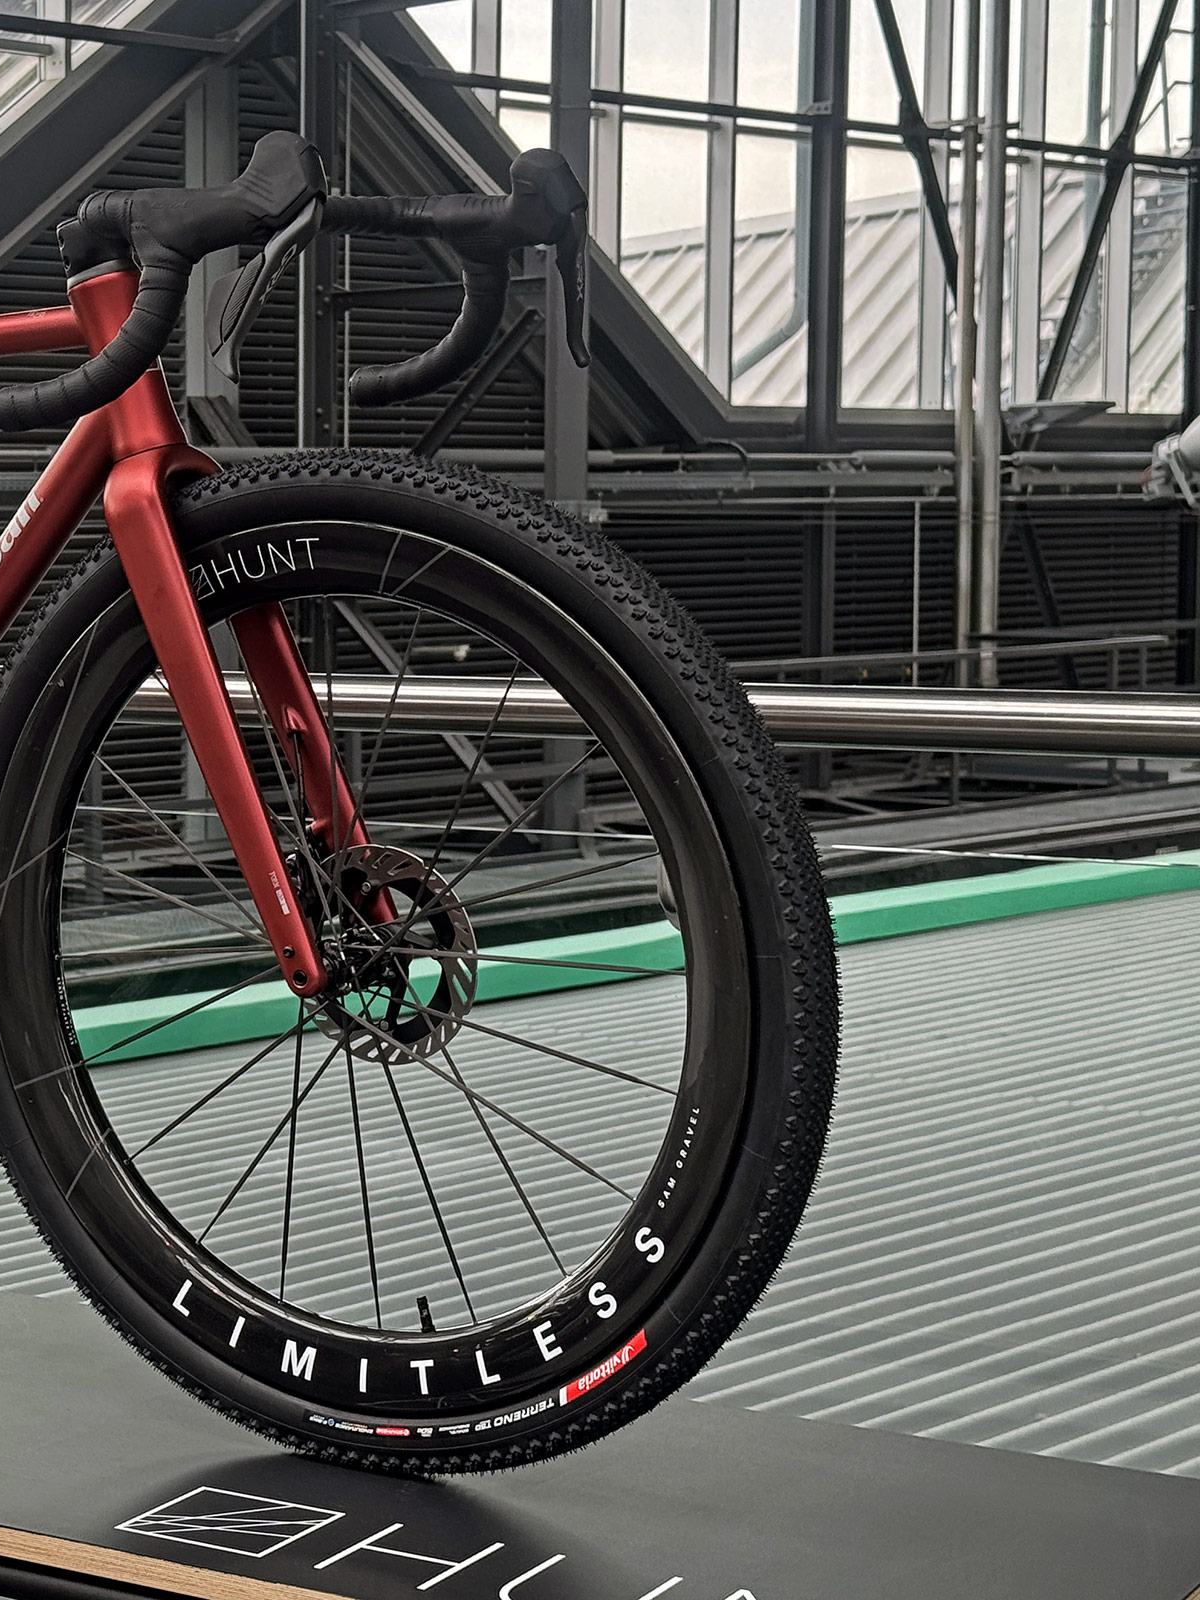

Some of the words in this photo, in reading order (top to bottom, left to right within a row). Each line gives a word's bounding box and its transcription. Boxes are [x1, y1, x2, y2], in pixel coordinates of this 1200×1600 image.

[210, 537, 320, 590] HUNT
[675, 1107, 701, 1169] GRAVEL
[171, 1226, 666, 1396] LIMITLESS
[577, 1354, 622, 1391] vittoria
[493, 1397, 555, 1428] TERRENO
[313, 1522, 758, 1600] HU
